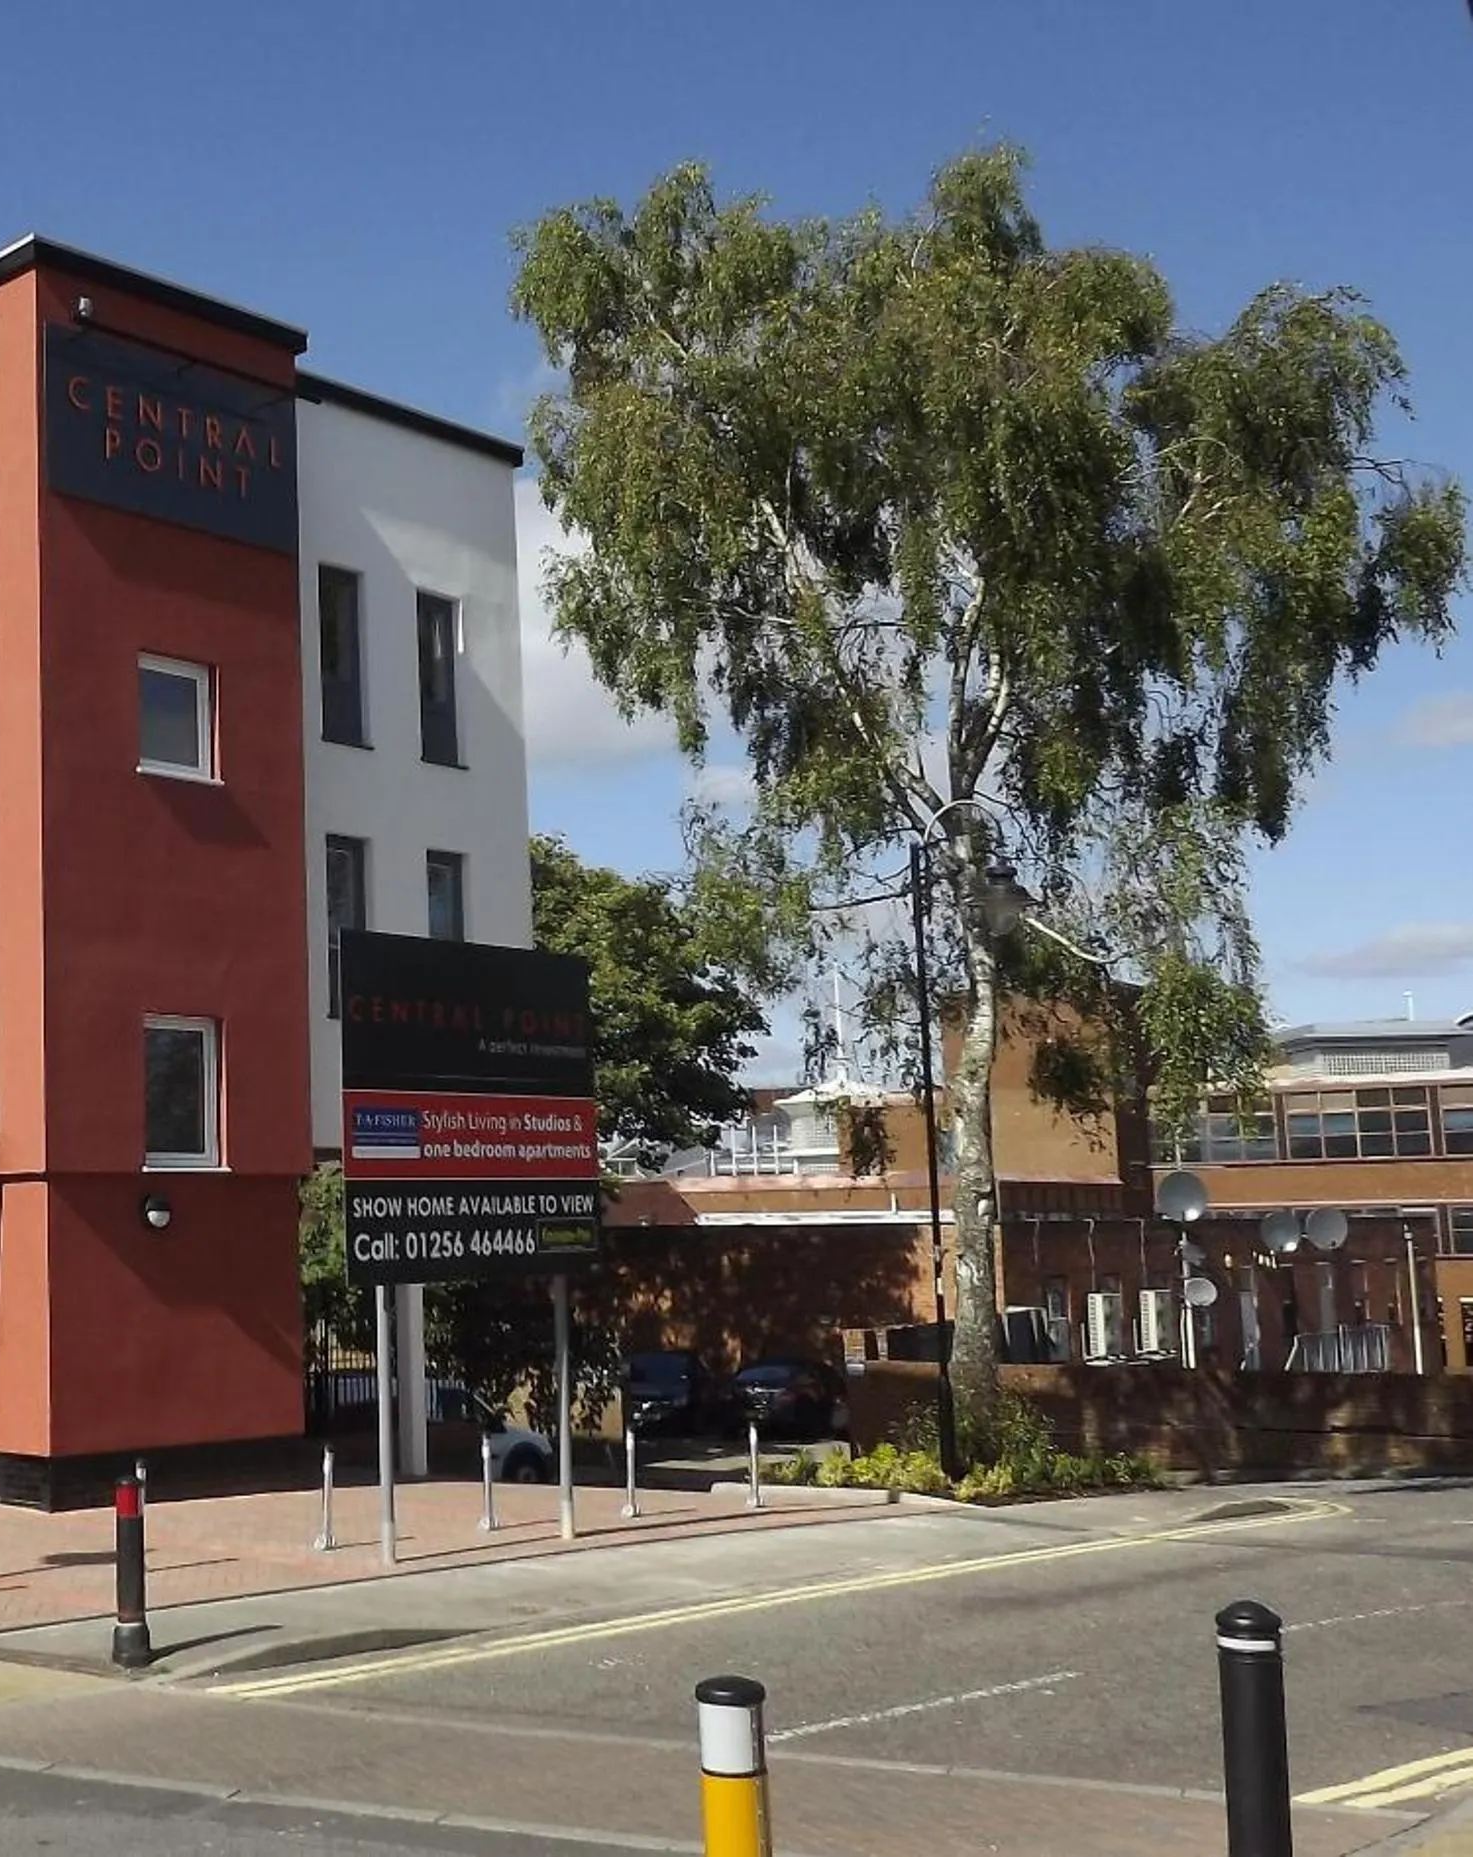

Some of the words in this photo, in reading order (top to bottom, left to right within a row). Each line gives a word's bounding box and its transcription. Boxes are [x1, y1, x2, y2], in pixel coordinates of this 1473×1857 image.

[68, 376, 281, 468] CENTRAL
[105, 427, 251, 498] POINT
[349, 995, 483, 1032] CENTRAL
[504, 1007, 586, 1035] POINT
[424, 1110, 465, 1132] Stylish
[469, 1113, 506, 1135] Living
[509, 1114, 523, 1130] in
[524, 1113, 571, 1132] Studios
[573, 1115, 583, 1132] &
[424, 1143, 451, 1158] one
[454, 1140, 516, 1158] bedroom
[518, 1142, 591, 1161] apartments
[353, 1197, 403, 1218] SHOW
[407, 1196, 455, 1217] HOME
[459, 1195, 536, 1216] AVAILABLE
[538, 1195, 557, 1214] TO
[561, 1195, 595, 1213] VIEW
[354, 1231, 401, 1261] Call:
[406, 1230, 464, 1260] 01256
[469, 1228, 536, 1256] 464466
